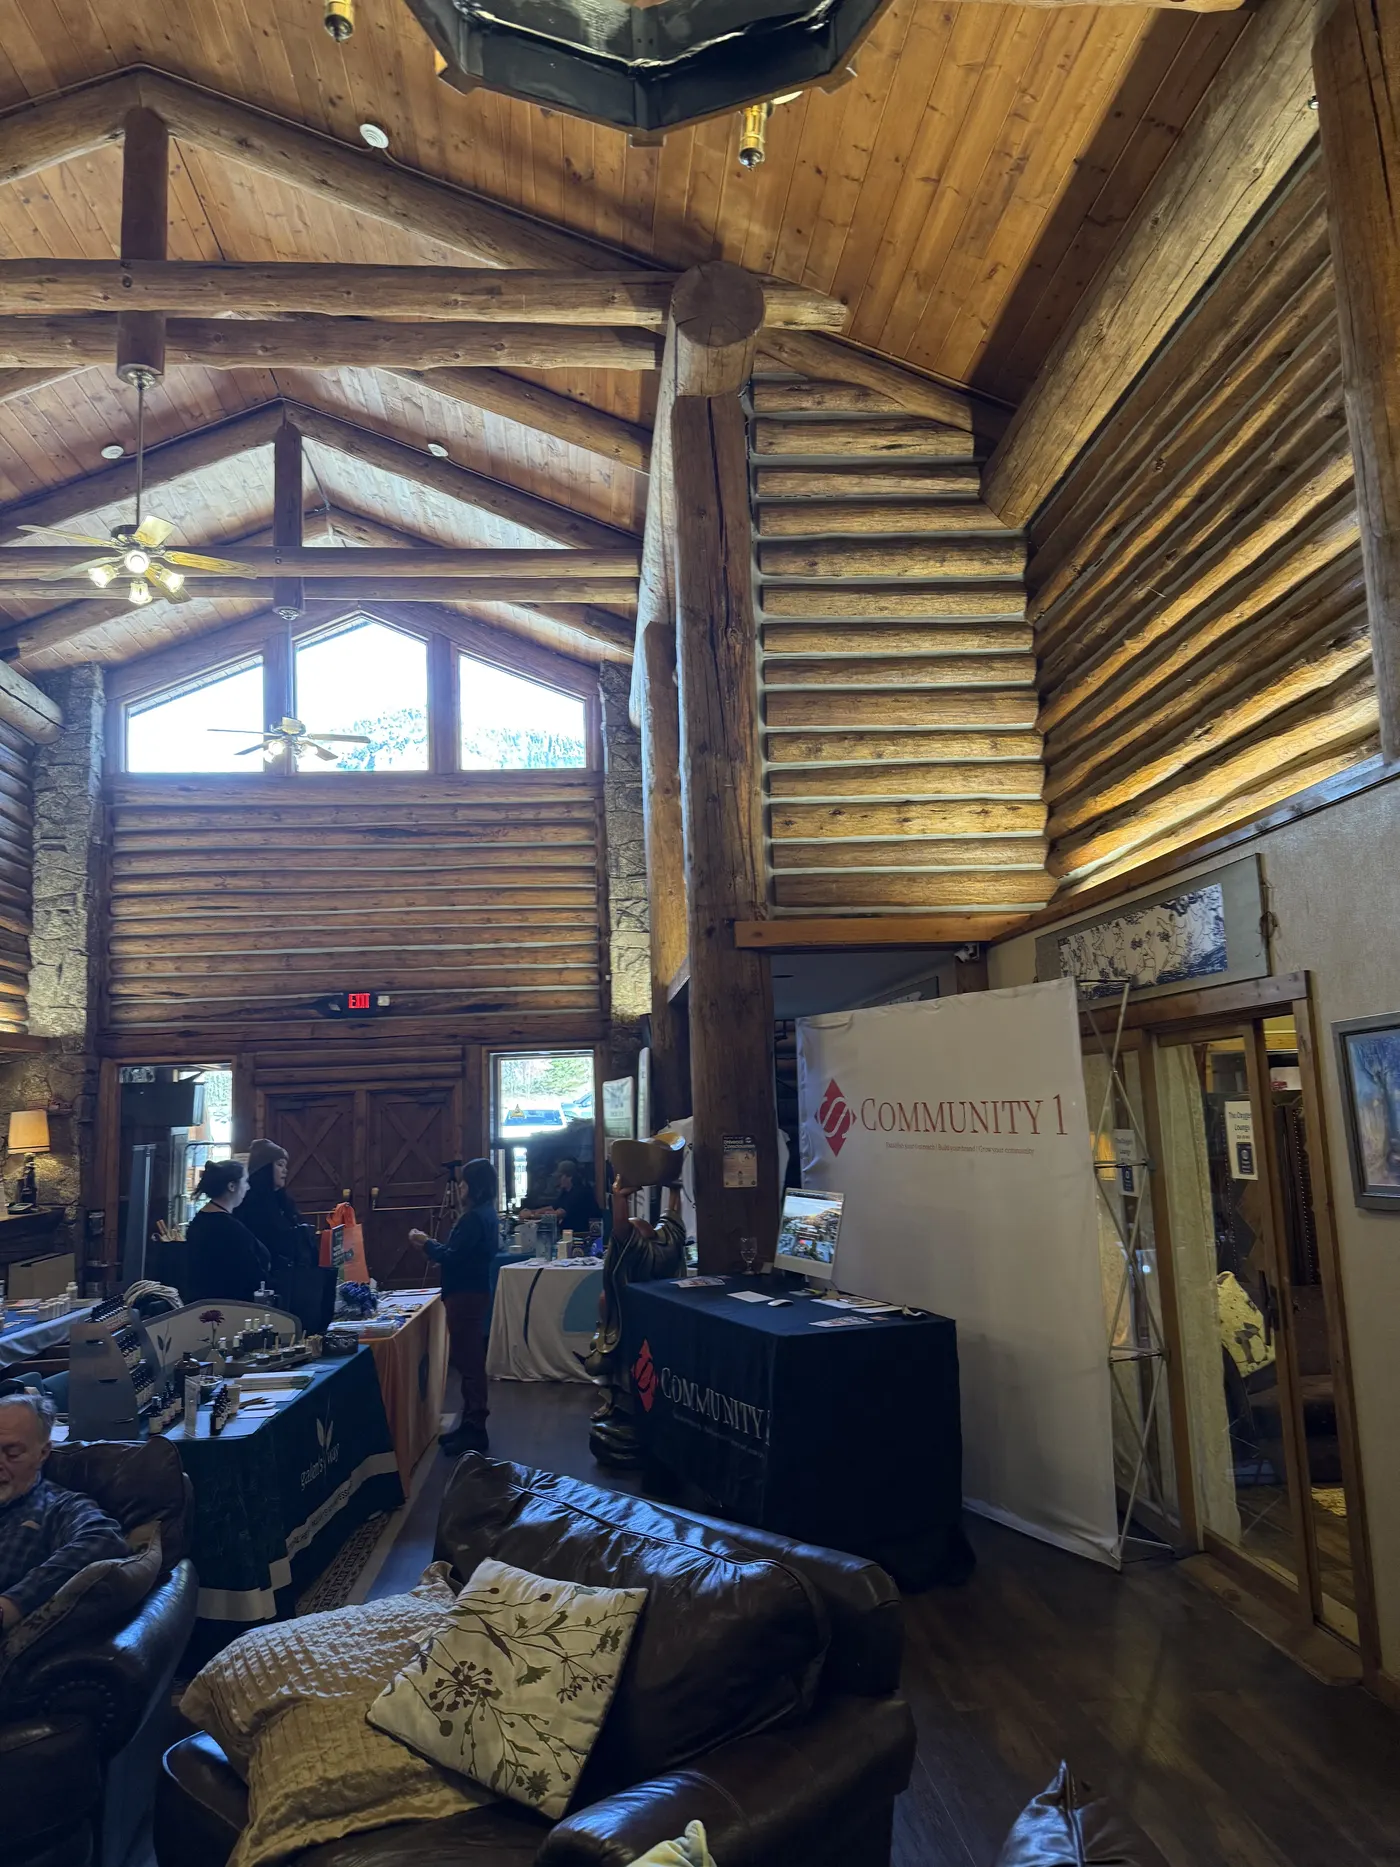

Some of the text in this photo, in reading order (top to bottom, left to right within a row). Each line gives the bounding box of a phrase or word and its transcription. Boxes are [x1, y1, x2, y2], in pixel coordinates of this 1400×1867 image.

[349, 993, 370, 1009] EXIT
[861, 1093, 1069, 1136] COMMUNITY 1
[1004, 1147, 1034, 1157] community
[661, 1367, 764, 1439] COMMUNITY
